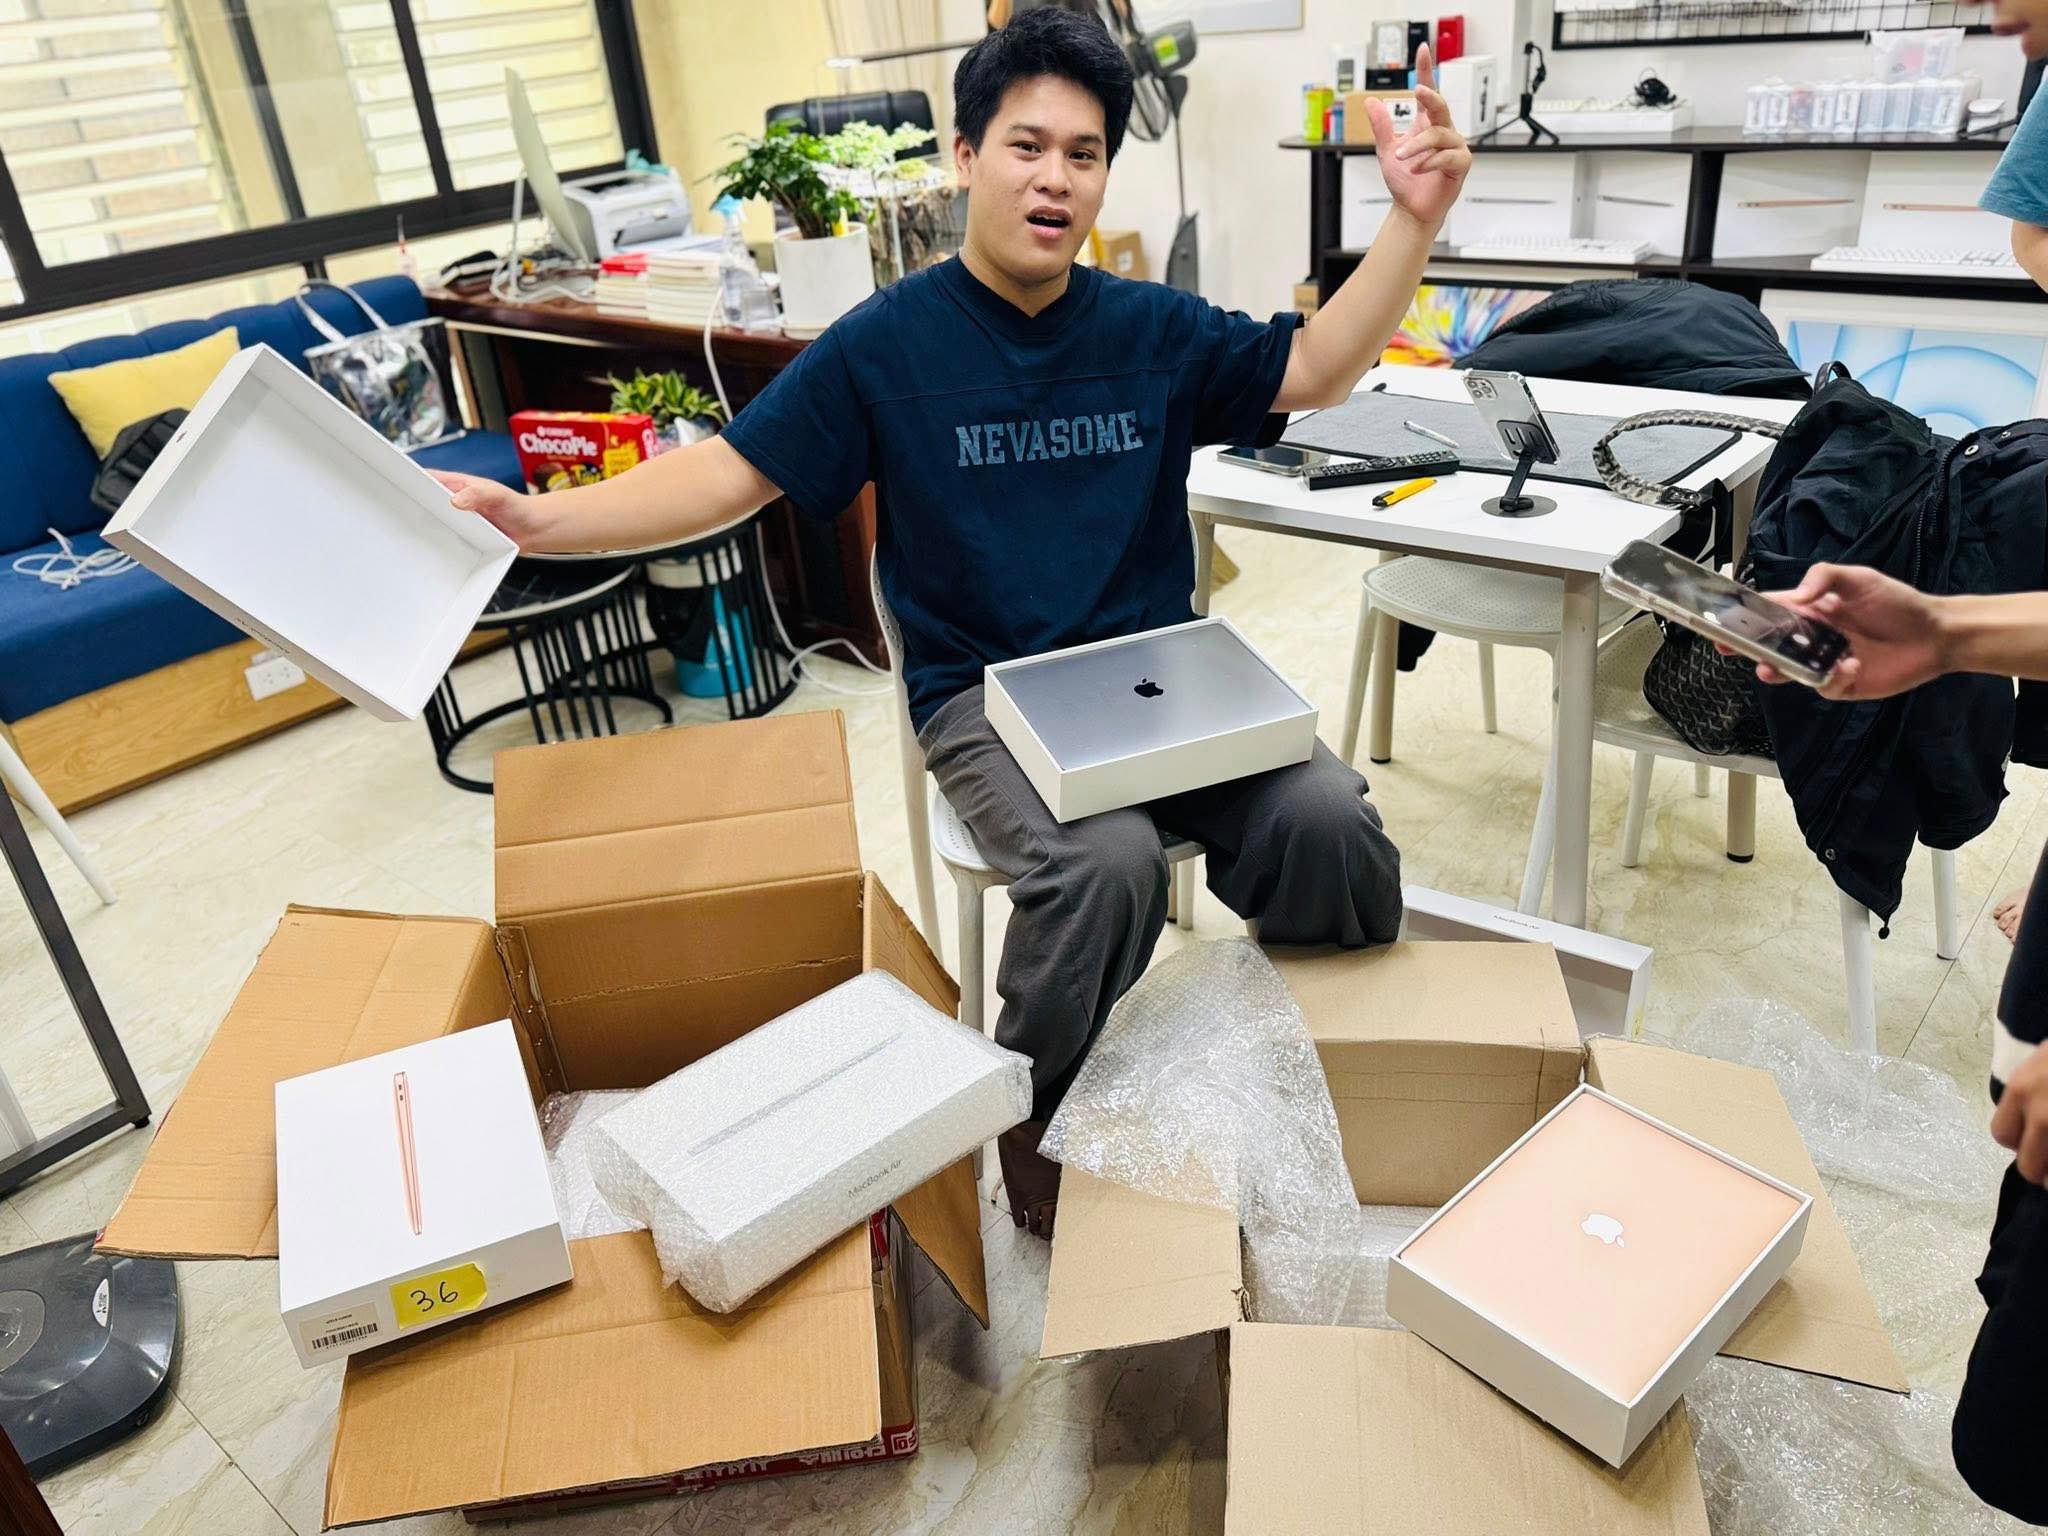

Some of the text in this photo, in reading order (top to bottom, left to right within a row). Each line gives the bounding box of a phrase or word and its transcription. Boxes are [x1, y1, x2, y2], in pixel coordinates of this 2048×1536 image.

[955, 410, 1144, 467] NEVASOME
[848, 1169, 889, 1199] MacBook
[410, 1281, 458, 1312] 36
